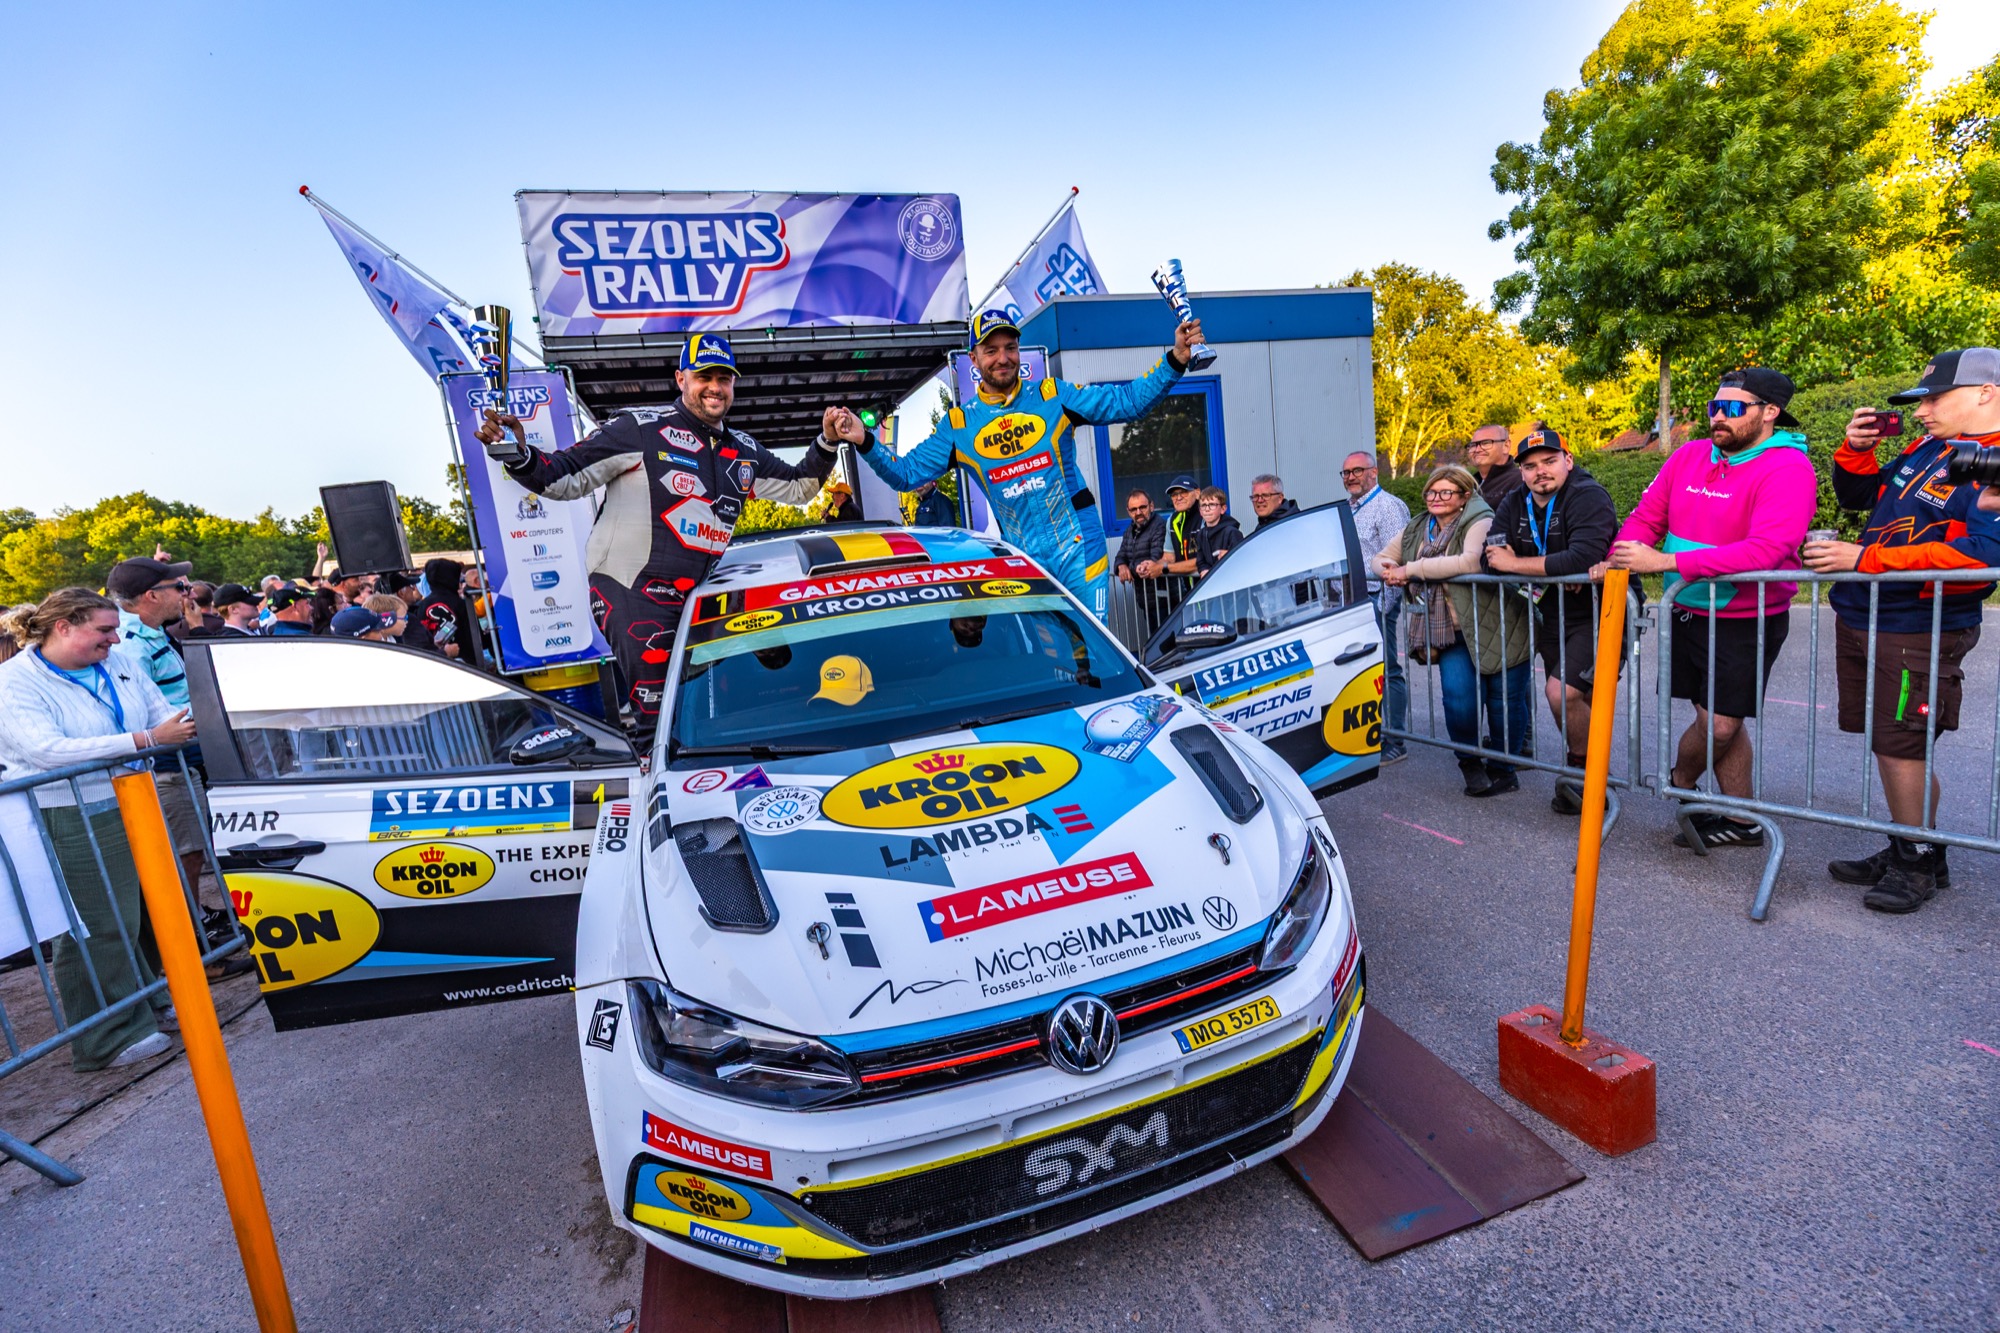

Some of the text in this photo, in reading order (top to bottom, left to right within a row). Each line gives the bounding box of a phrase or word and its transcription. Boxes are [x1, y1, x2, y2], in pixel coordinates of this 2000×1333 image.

[906, 204, 950, 230] RACING TEAM
[560, 219, 776, 260] SEZOENS
[905, 231, 946, 255] MOUSTACHE
[592, 263, 735, 304] RALLY
[983, 421, 1036, 449] KROON
[999, 440, 1024, 456] OIL
[992, 456, 1049, 480] LAMEUSE
[510, 527, 563, 539] VBC COMPUTERS
[779, 564, 994, 600] GALVAMETAUX
[988, 584, 1024, 592] KROON
[716, 593, 728, 615] 1
[806, 585, 962, 616] KROON-OIL
[733, 614, 775, 628] KROON
[745, 621, 764, 631] OIL
[1202, 643, 1299, 691] SEZOENS
[773, 786, 801, 796] YEARS
[858, 756, 1046, 810] KROON
[385, 784, 554, 815] SEZOENS
[753, 792, 811, 813] BELGIAN
[921, 786, 1009, 818] OIL
[597, 816, 608, 854] MOTORSPORT
[605, 816, 629, 852] PBO
[766, 814, 805, 829] CLUB
[496, 844, 590, 863] THE EXPE
[879, 812, 1053, 868] LAMBDA
[392, 861, 477, 882] KROON
[417, 880, 455, 895] OIL
[948, 862, 1137, 924] LAMEUSE
[981, 960, 1077, 998] Fosses-la-Ville
[1158, 929, 1201, 949] Fleurus
[1189, 999, 1275, 1046] MQ 5573
[654, 1124, 763, 1172] LAMEUSE
[667, 1182, 737, 1210] KROON
[689, 1200, 721, 1218] OIL
[693, 1227, 759, 1253] MICHELIN
